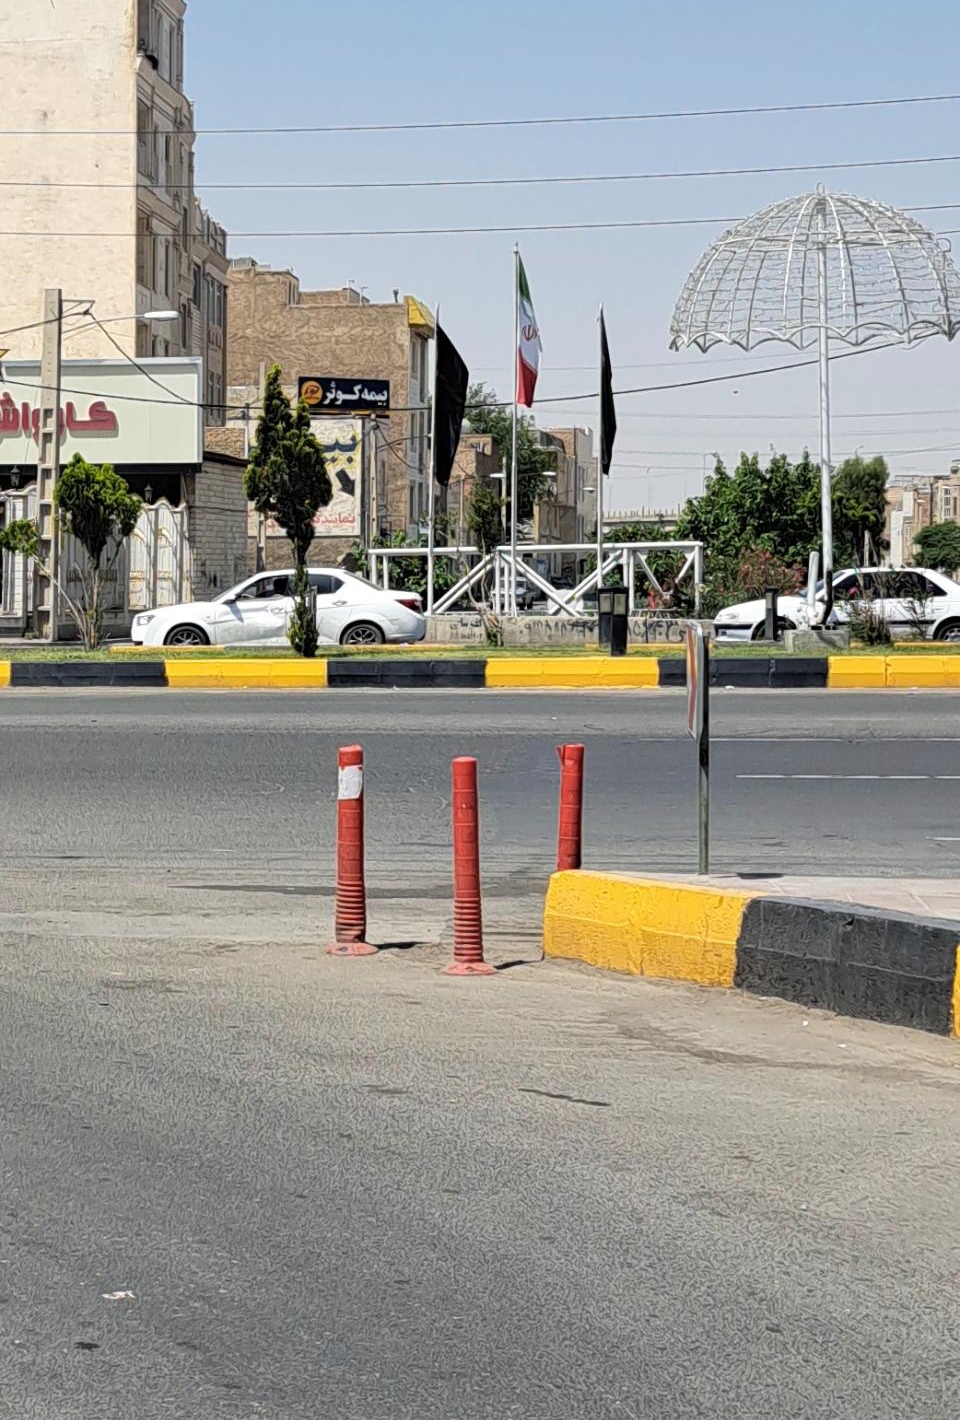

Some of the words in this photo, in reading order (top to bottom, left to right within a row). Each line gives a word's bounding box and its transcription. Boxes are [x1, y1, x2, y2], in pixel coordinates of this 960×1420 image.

[323, 380, 362, 405] کوثر
[361, 386, 389, 407] بیمه
[313, 514, 356, 526] نمایندگ
